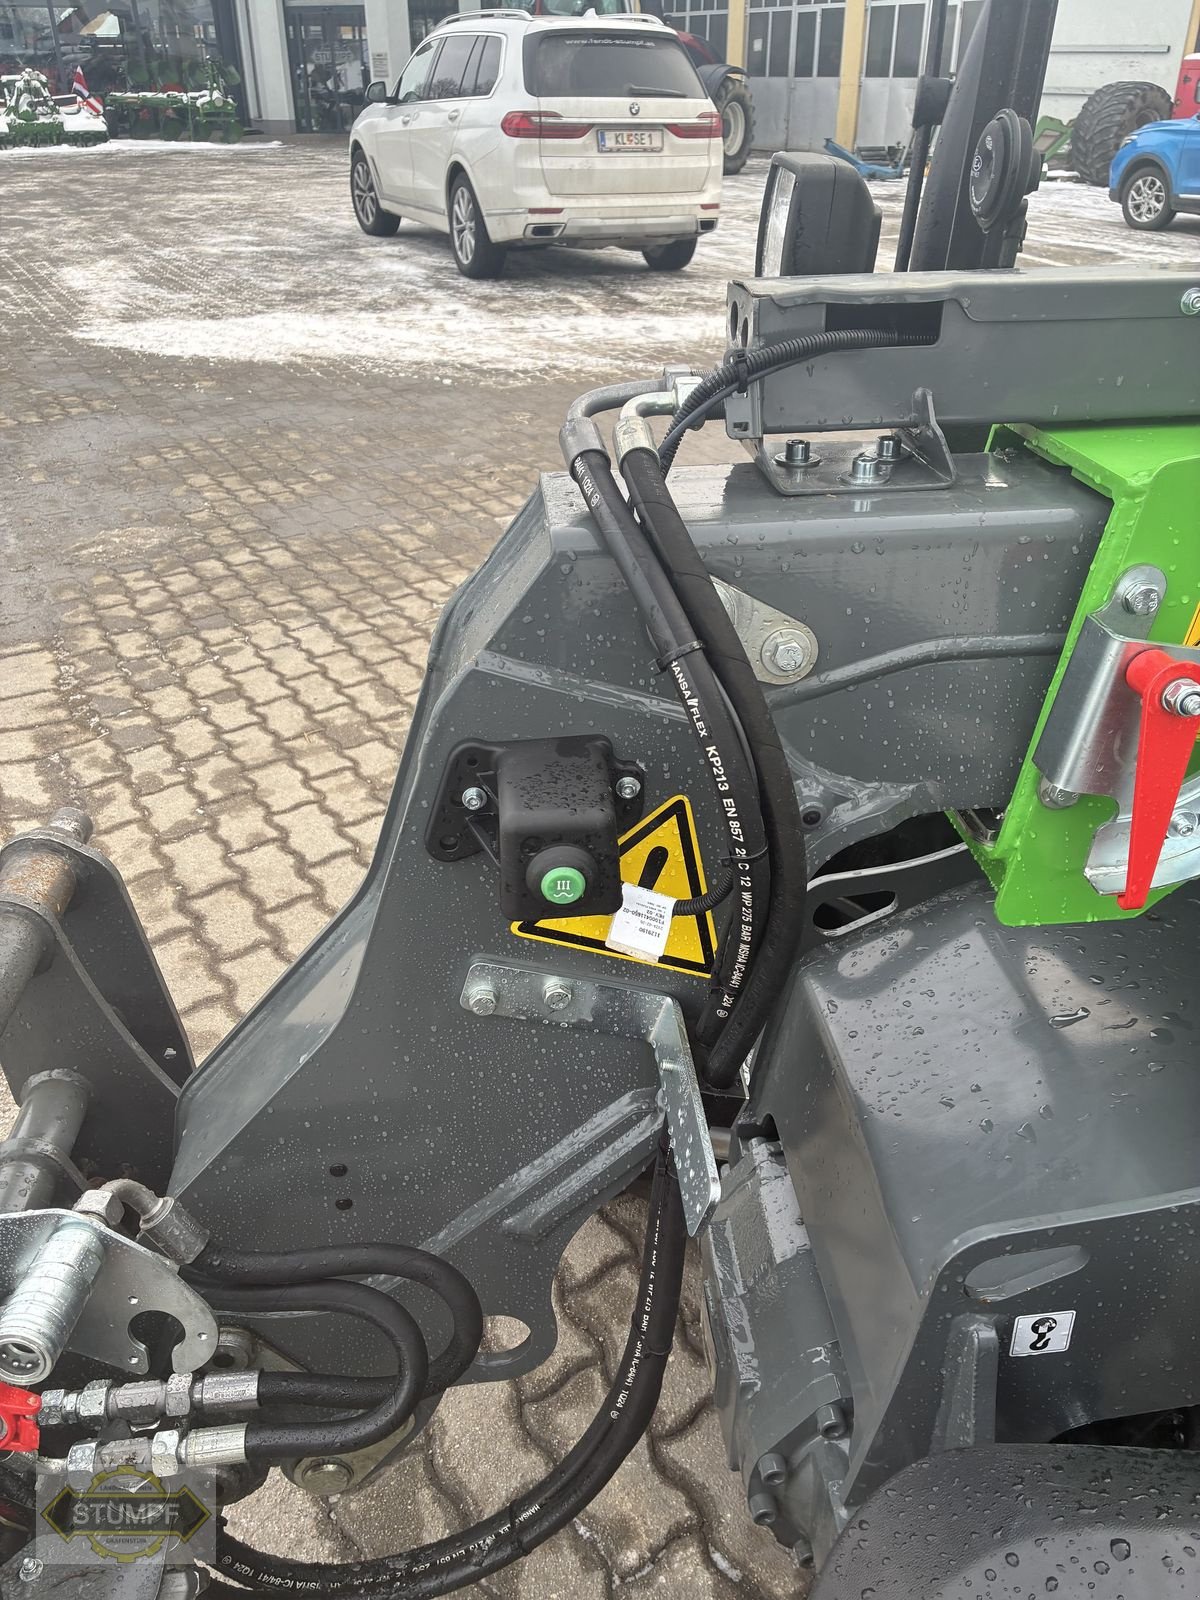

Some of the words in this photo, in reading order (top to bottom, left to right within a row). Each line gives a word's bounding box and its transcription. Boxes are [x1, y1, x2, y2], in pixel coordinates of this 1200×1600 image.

[615, 133, 626, 145] KL
[634, 133, 646, 145] SE
[648, 133, 653, 145] 1
[705, 745, 730, 791] KP213
[723, 798, 738, 817] EN
[729, 820, 744, 842] 857
[740, 875, 752, 887] 12
[741, 891, 752, 907] WP
[741, 906, 753, 922] 275
[740, 924, 752, 942] BAR
[233, 1562, 255, 1577] 1Q24
[257, 1572, 293, 1588] IC-84/41
